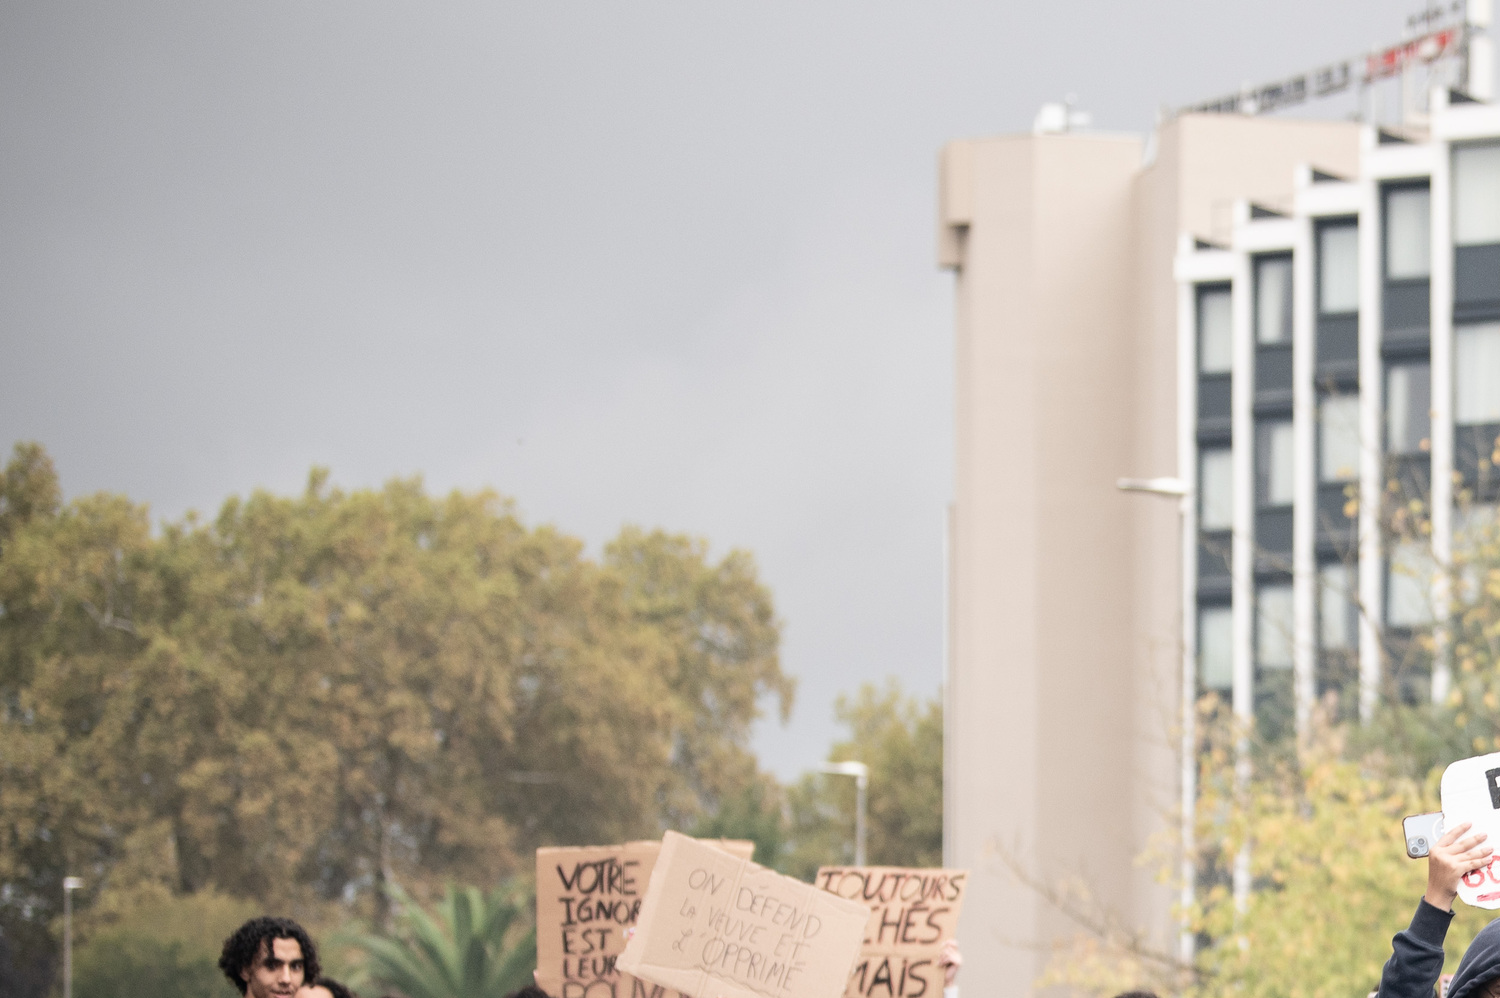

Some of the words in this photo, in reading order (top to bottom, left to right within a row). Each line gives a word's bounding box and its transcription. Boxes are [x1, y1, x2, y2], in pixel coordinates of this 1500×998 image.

[556, 856, 640, 896] VOTRE
[688, 868, 725, 896] ON
[679, 897, 697, 919] LA
[708, 906, 768, 945] VEUVE
[773, 932, 811, 960] ET
[735, 885, 822, 940] DÉFEND
[562, 928, 612, 955] EST
[563, 955, 621, 979] LEUR
